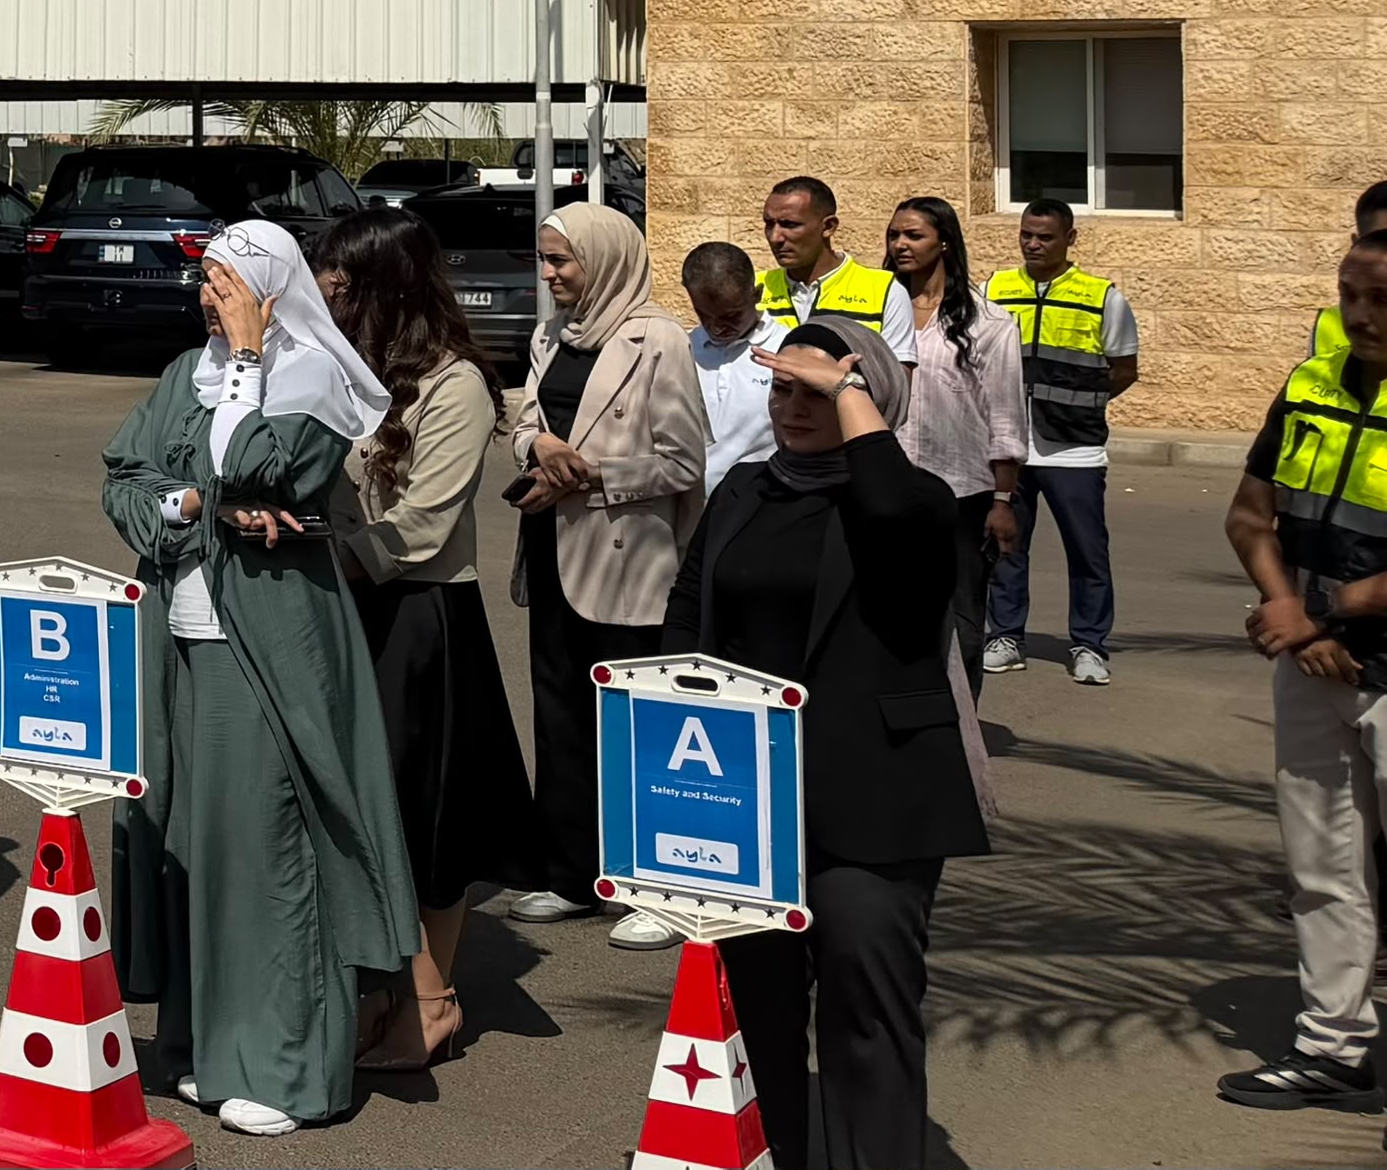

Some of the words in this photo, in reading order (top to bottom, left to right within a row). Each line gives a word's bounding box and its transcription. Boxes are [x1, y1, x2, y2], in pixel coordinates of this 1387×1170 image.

[29, 609, 71, 661] B
[23, 672, 80, 687] Administration
[45, 685, 58, 693] HR
[42, 693, 61, 703] CSR
[31, 726, 73, 742] ayla
[667, 716, 724, 777] A
[650, 785, 680, 798] Safety
[682, 789, 700, 800] and
[702, 792, 742, 806] Security
[671, 846, 723, 864] ayla
